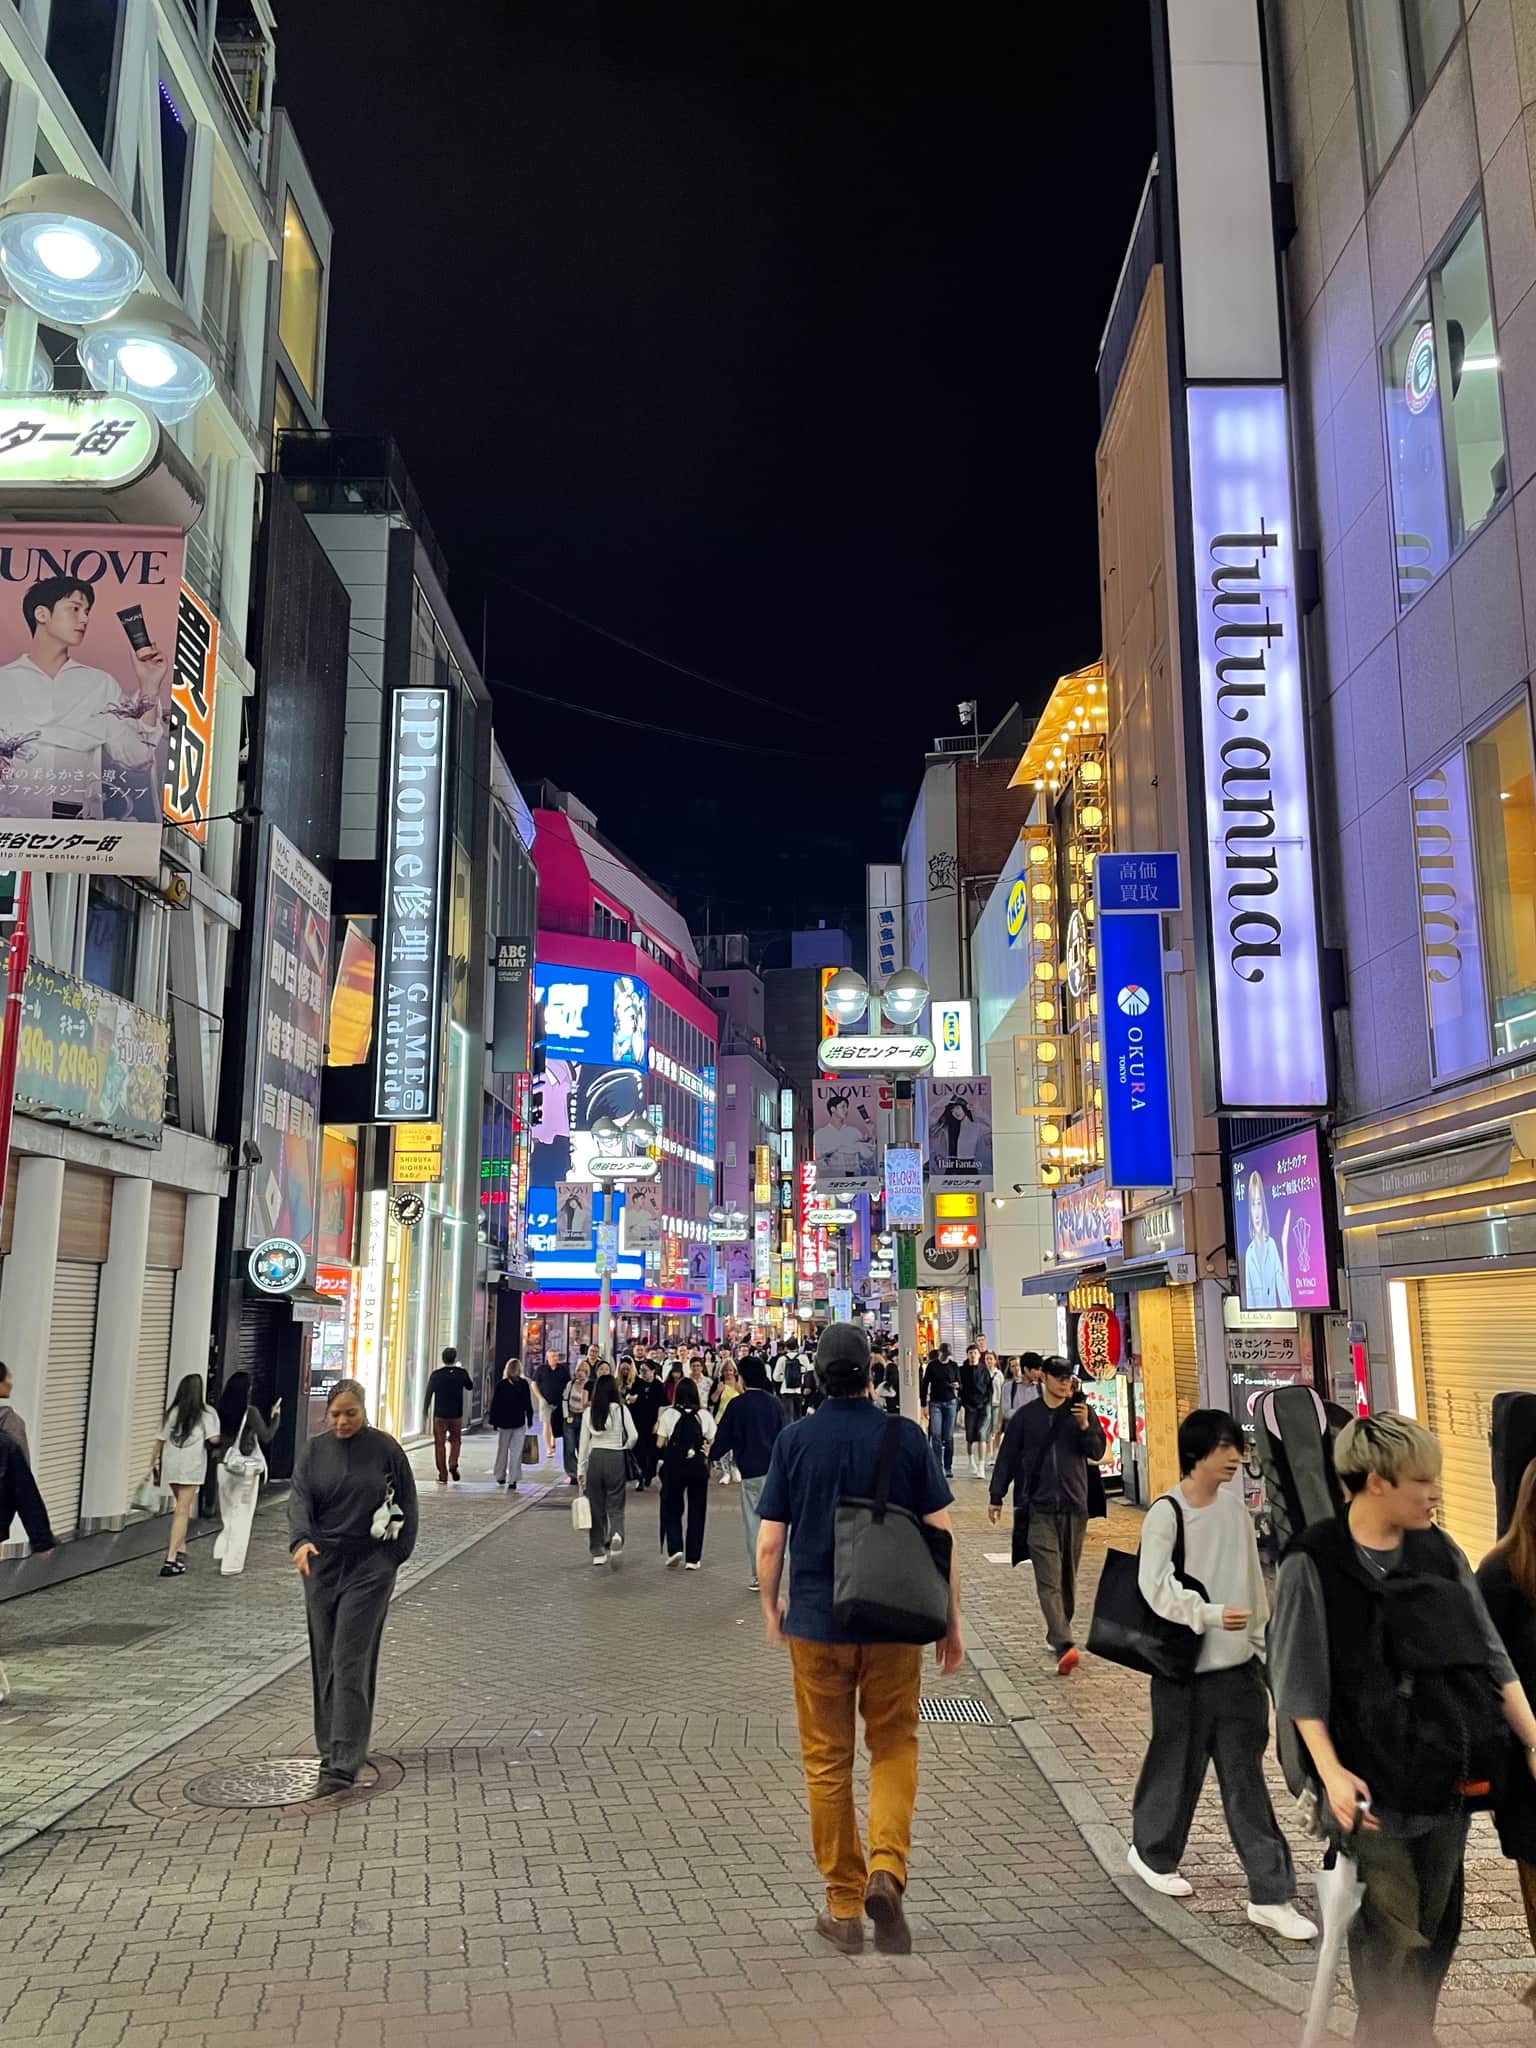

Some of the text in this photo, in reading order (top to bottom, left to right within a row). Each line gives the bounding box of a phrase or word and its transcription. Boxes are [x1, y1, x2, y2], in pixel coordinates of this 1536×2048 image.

[0, 547, 168, 585] UNOVE
[1120, 861, 1158, 880] 高価
[1120, 884, 1159, 902] 買取
[499, 945, 526, 958] ABC
[498, 958, 526, 968] MART
[384, 983, 405, 1093] Android
[404, 982, 429, 1085] GAME
[948, 1015, 956, 1047] IKEA
[825, 1045, 929, 1059] 渋谷センター街
[1119, 1056, 1127, 1084] TOKYO
[1128, 1027, 1147, 1111] OKURA
[817, 1084, 872, 1100] UNOVE
[932, 1083, 988, 1096] UNOVE
[1088, 1311, 1109, 1370] 備長炭火焼
[1232, 1373, 1245, 1385] 3F
